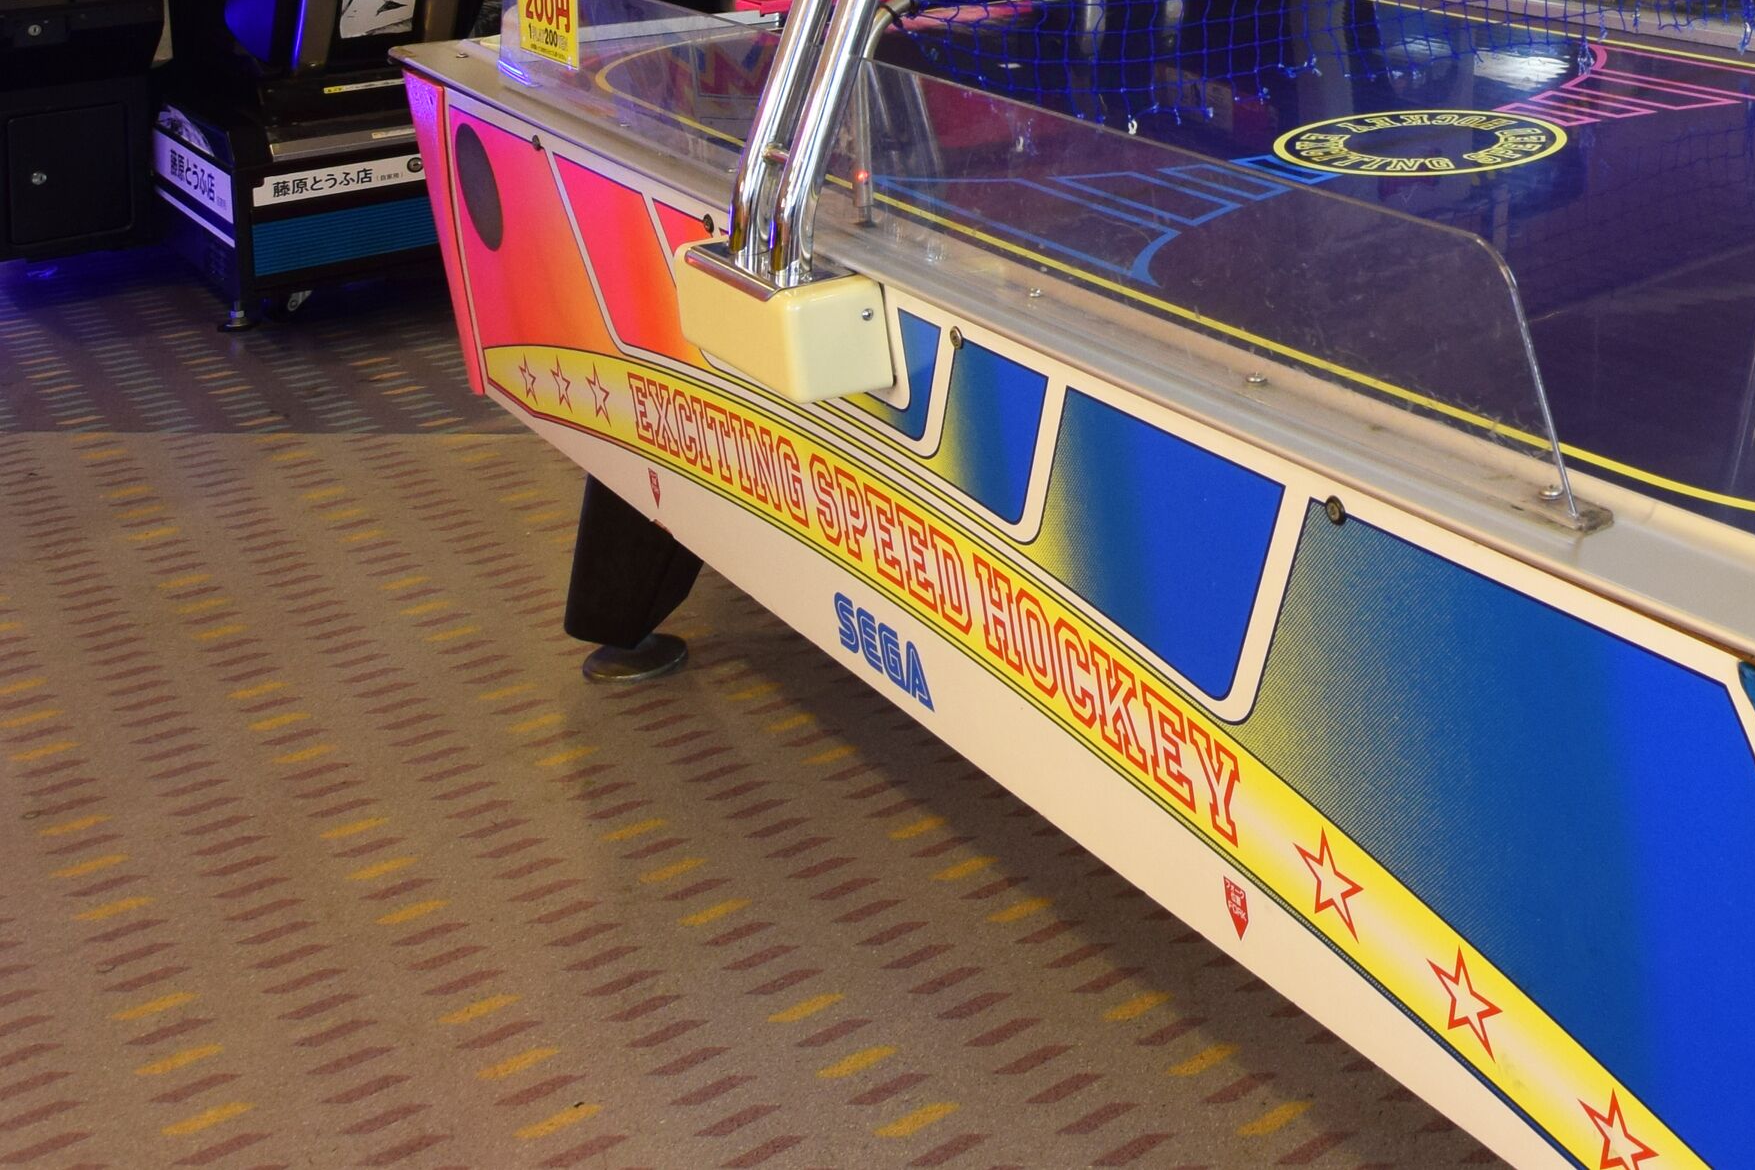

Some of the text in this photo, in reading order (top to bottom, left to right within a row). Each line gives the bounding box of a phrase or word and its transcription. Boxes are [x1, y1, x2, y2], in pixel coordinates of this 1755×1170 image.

[169, 148, 216, 202] 藤原とうふ店
[272, 168, 373, 199] 藤原とうふ店
[627, 371, 1241, 848] EXCITING SPEED HOCKEY
[834, 592, 935, 712] SEGA
